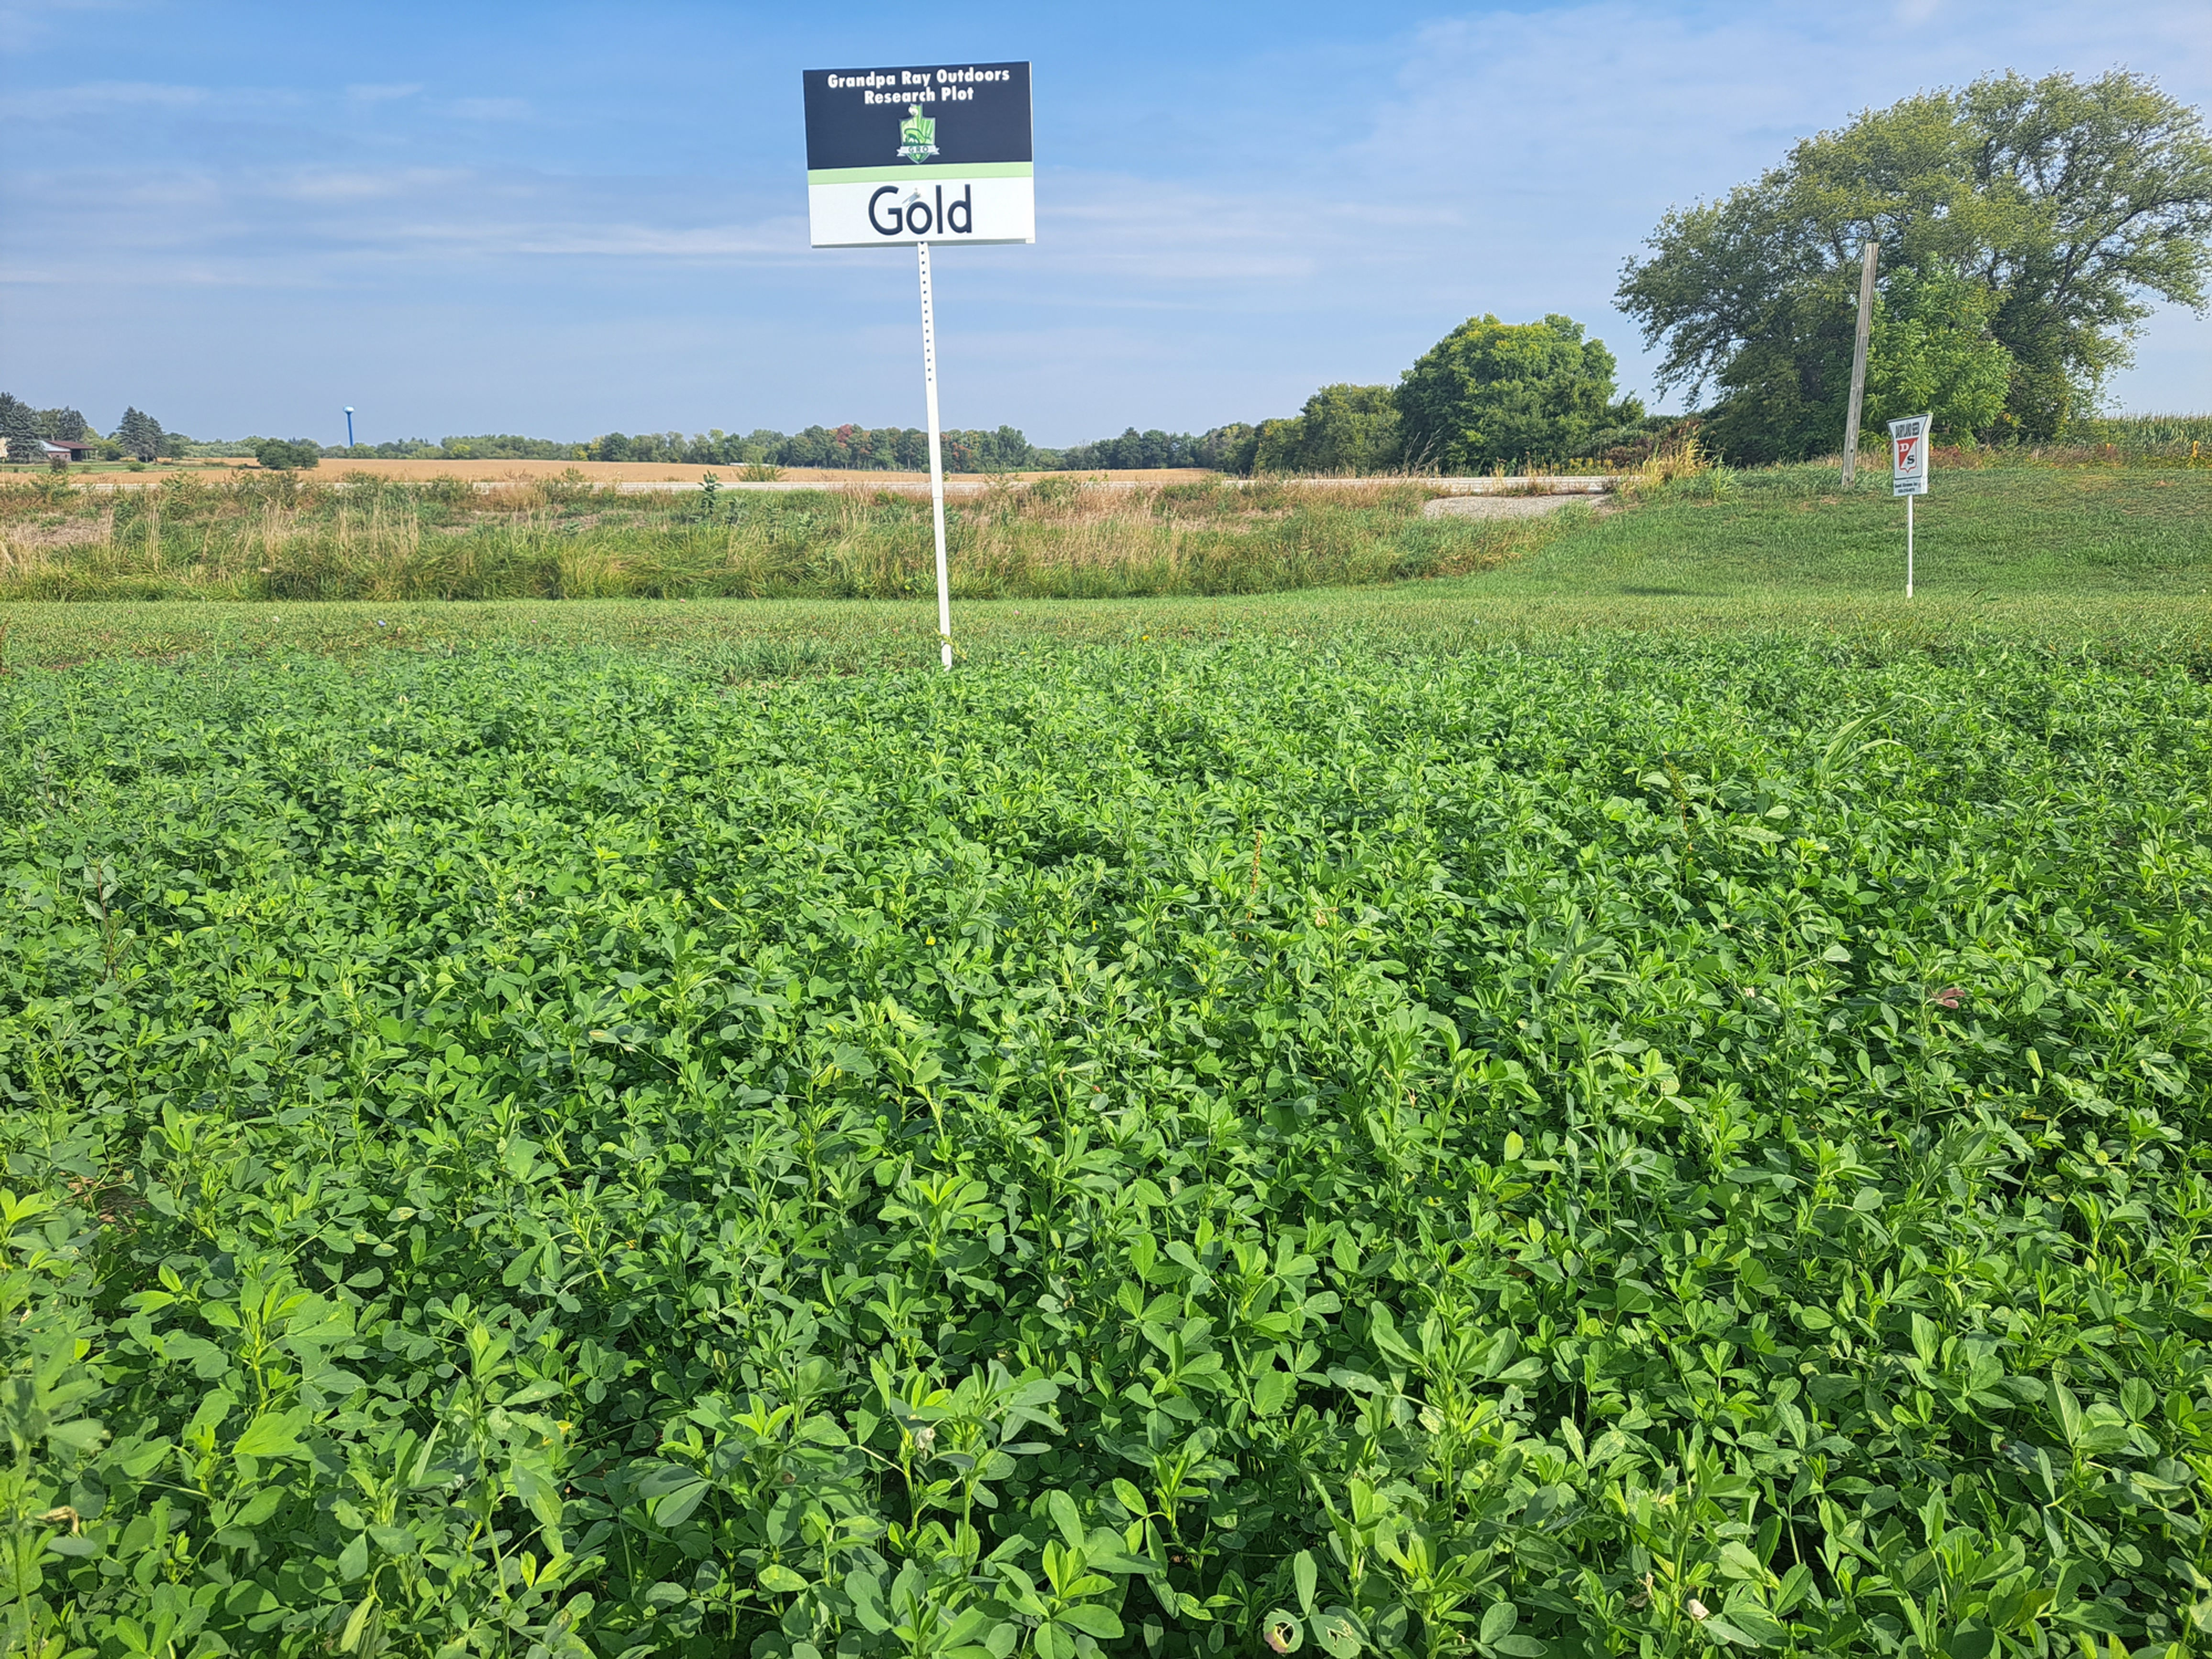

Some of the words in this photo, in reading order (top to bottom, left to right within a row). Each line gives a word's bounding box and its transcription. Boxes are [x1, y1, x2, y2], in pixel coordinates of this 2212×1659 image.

[828, 71, 896, 89] Grandpa
[902, 70, 931, 87] Ray
[936, 67, 1010, 84] Outdoors
[864, 87, 935, 104] Research
[941, 86, 974, 101] Plot
[869, 184, 972, 236] Gold
[1900, 442, 1910, 452] D
[1907, 454, 1915, 465] S
